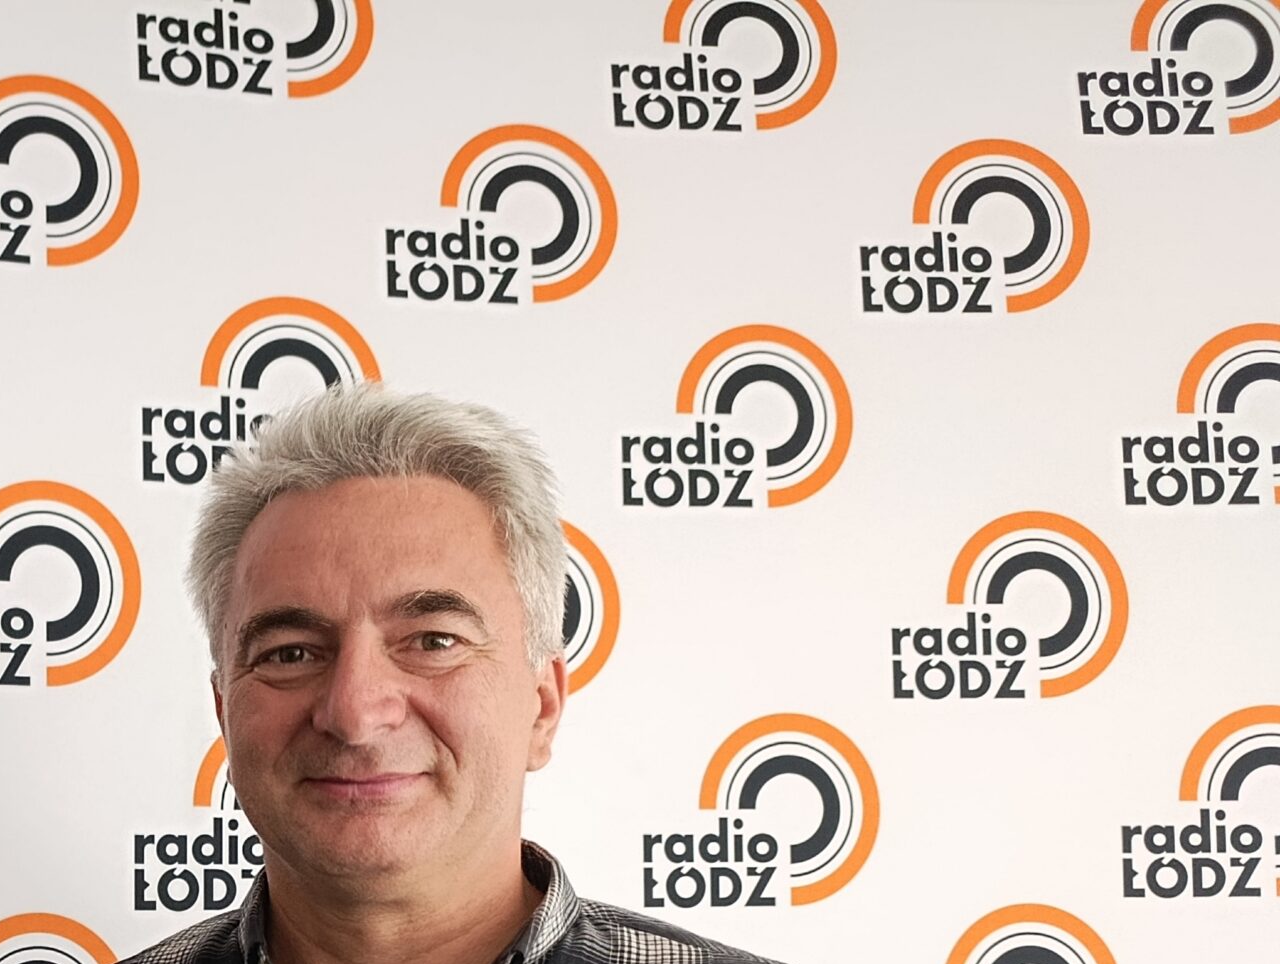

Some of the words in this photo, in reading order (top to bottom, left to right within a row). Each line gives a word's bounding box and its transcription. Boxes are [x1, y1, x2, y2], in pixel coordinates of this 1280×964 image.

[137, 8, 274, 55] radio
[611, 52, 742, 94] radio
[1077, 57, 1214, 98] radio
[385, 218, 520, 263] radio
[860, 231, 992, 273] radio
[621, 421, 755, 466] radio
[1122, 421, 1260, 464] radio
[891, 612, 1027, 657] radio
[643, 817, 778, 864] radio
[1122, 808, 1263, 855] radio
